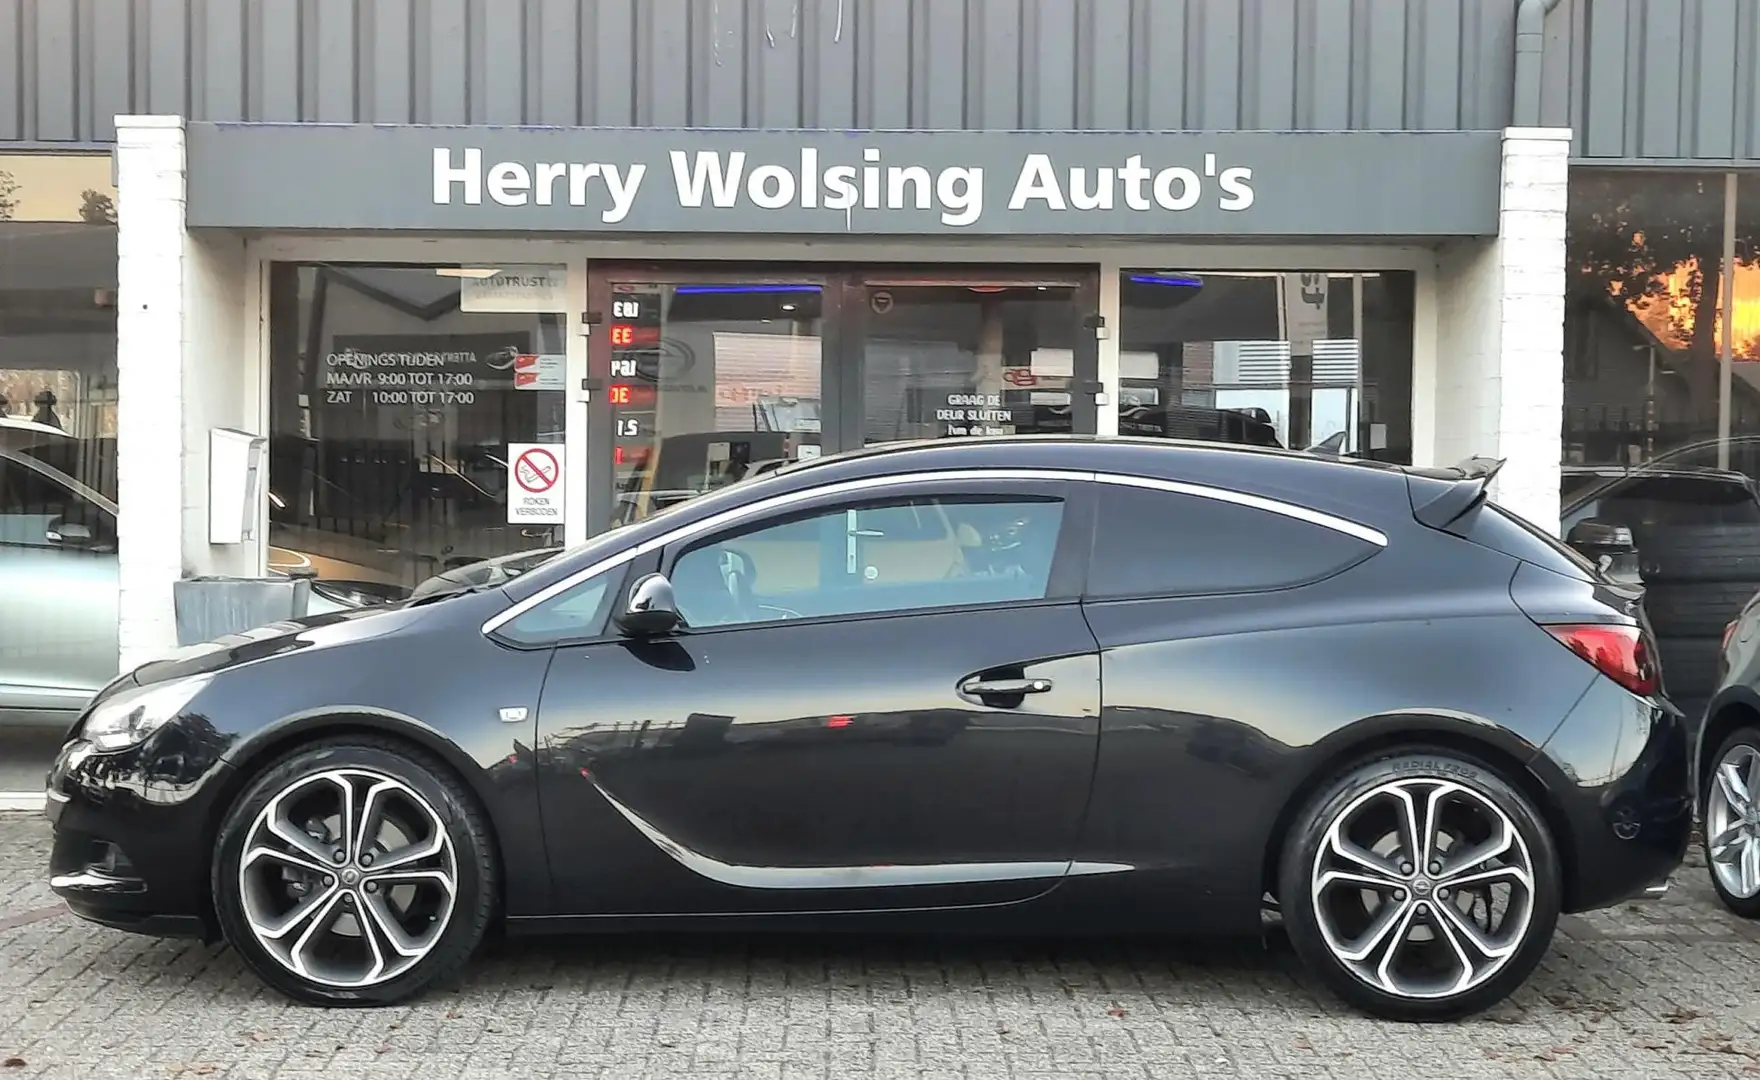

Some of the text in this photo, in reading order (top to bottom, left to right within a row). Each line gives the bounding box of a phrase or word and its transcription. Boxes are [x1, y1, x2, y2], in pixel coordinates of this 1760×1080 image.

[432, 147, 1256, 226] Herry Wolsing Auto's
[377, 372, 406, 386] 9:00
[407, 372, 435, 386] TOT
[438, 372, 473, 386] 17:00
[326, 390, 475, 404] ZAT 10:00 TOT 17:00
[947, 394, 1001, 406] GRAAG DE
[936, 409, 1012, 421] DEUR SLUITEN
